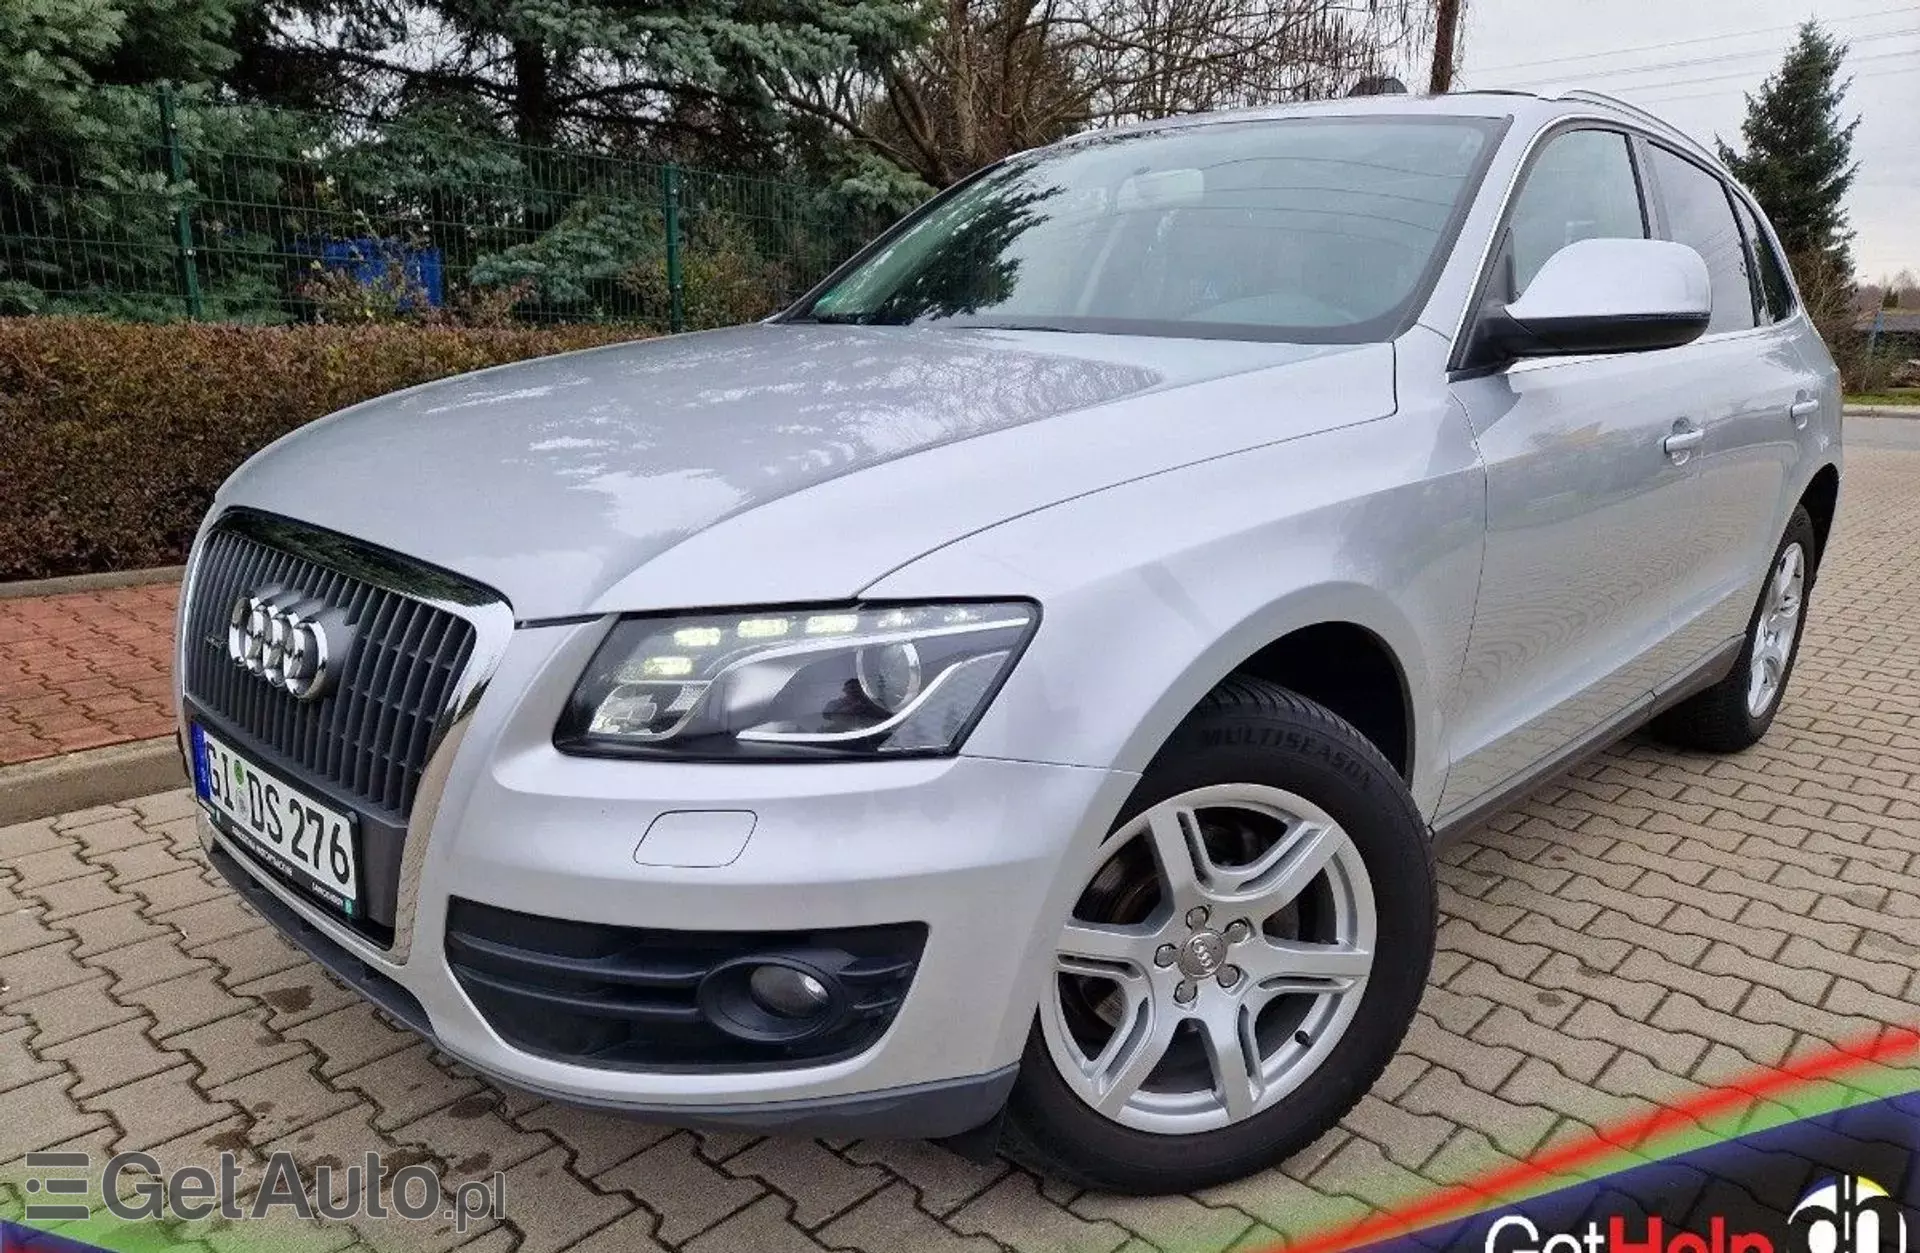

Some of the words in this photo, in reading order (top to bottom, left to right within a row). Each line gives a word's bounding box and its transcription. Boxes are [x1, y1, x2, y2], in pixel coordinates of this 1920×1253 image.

[206, 740, 235, 811] GI
[247, 770, 283, 845] DS
[289, 798, 350, 884] 276
